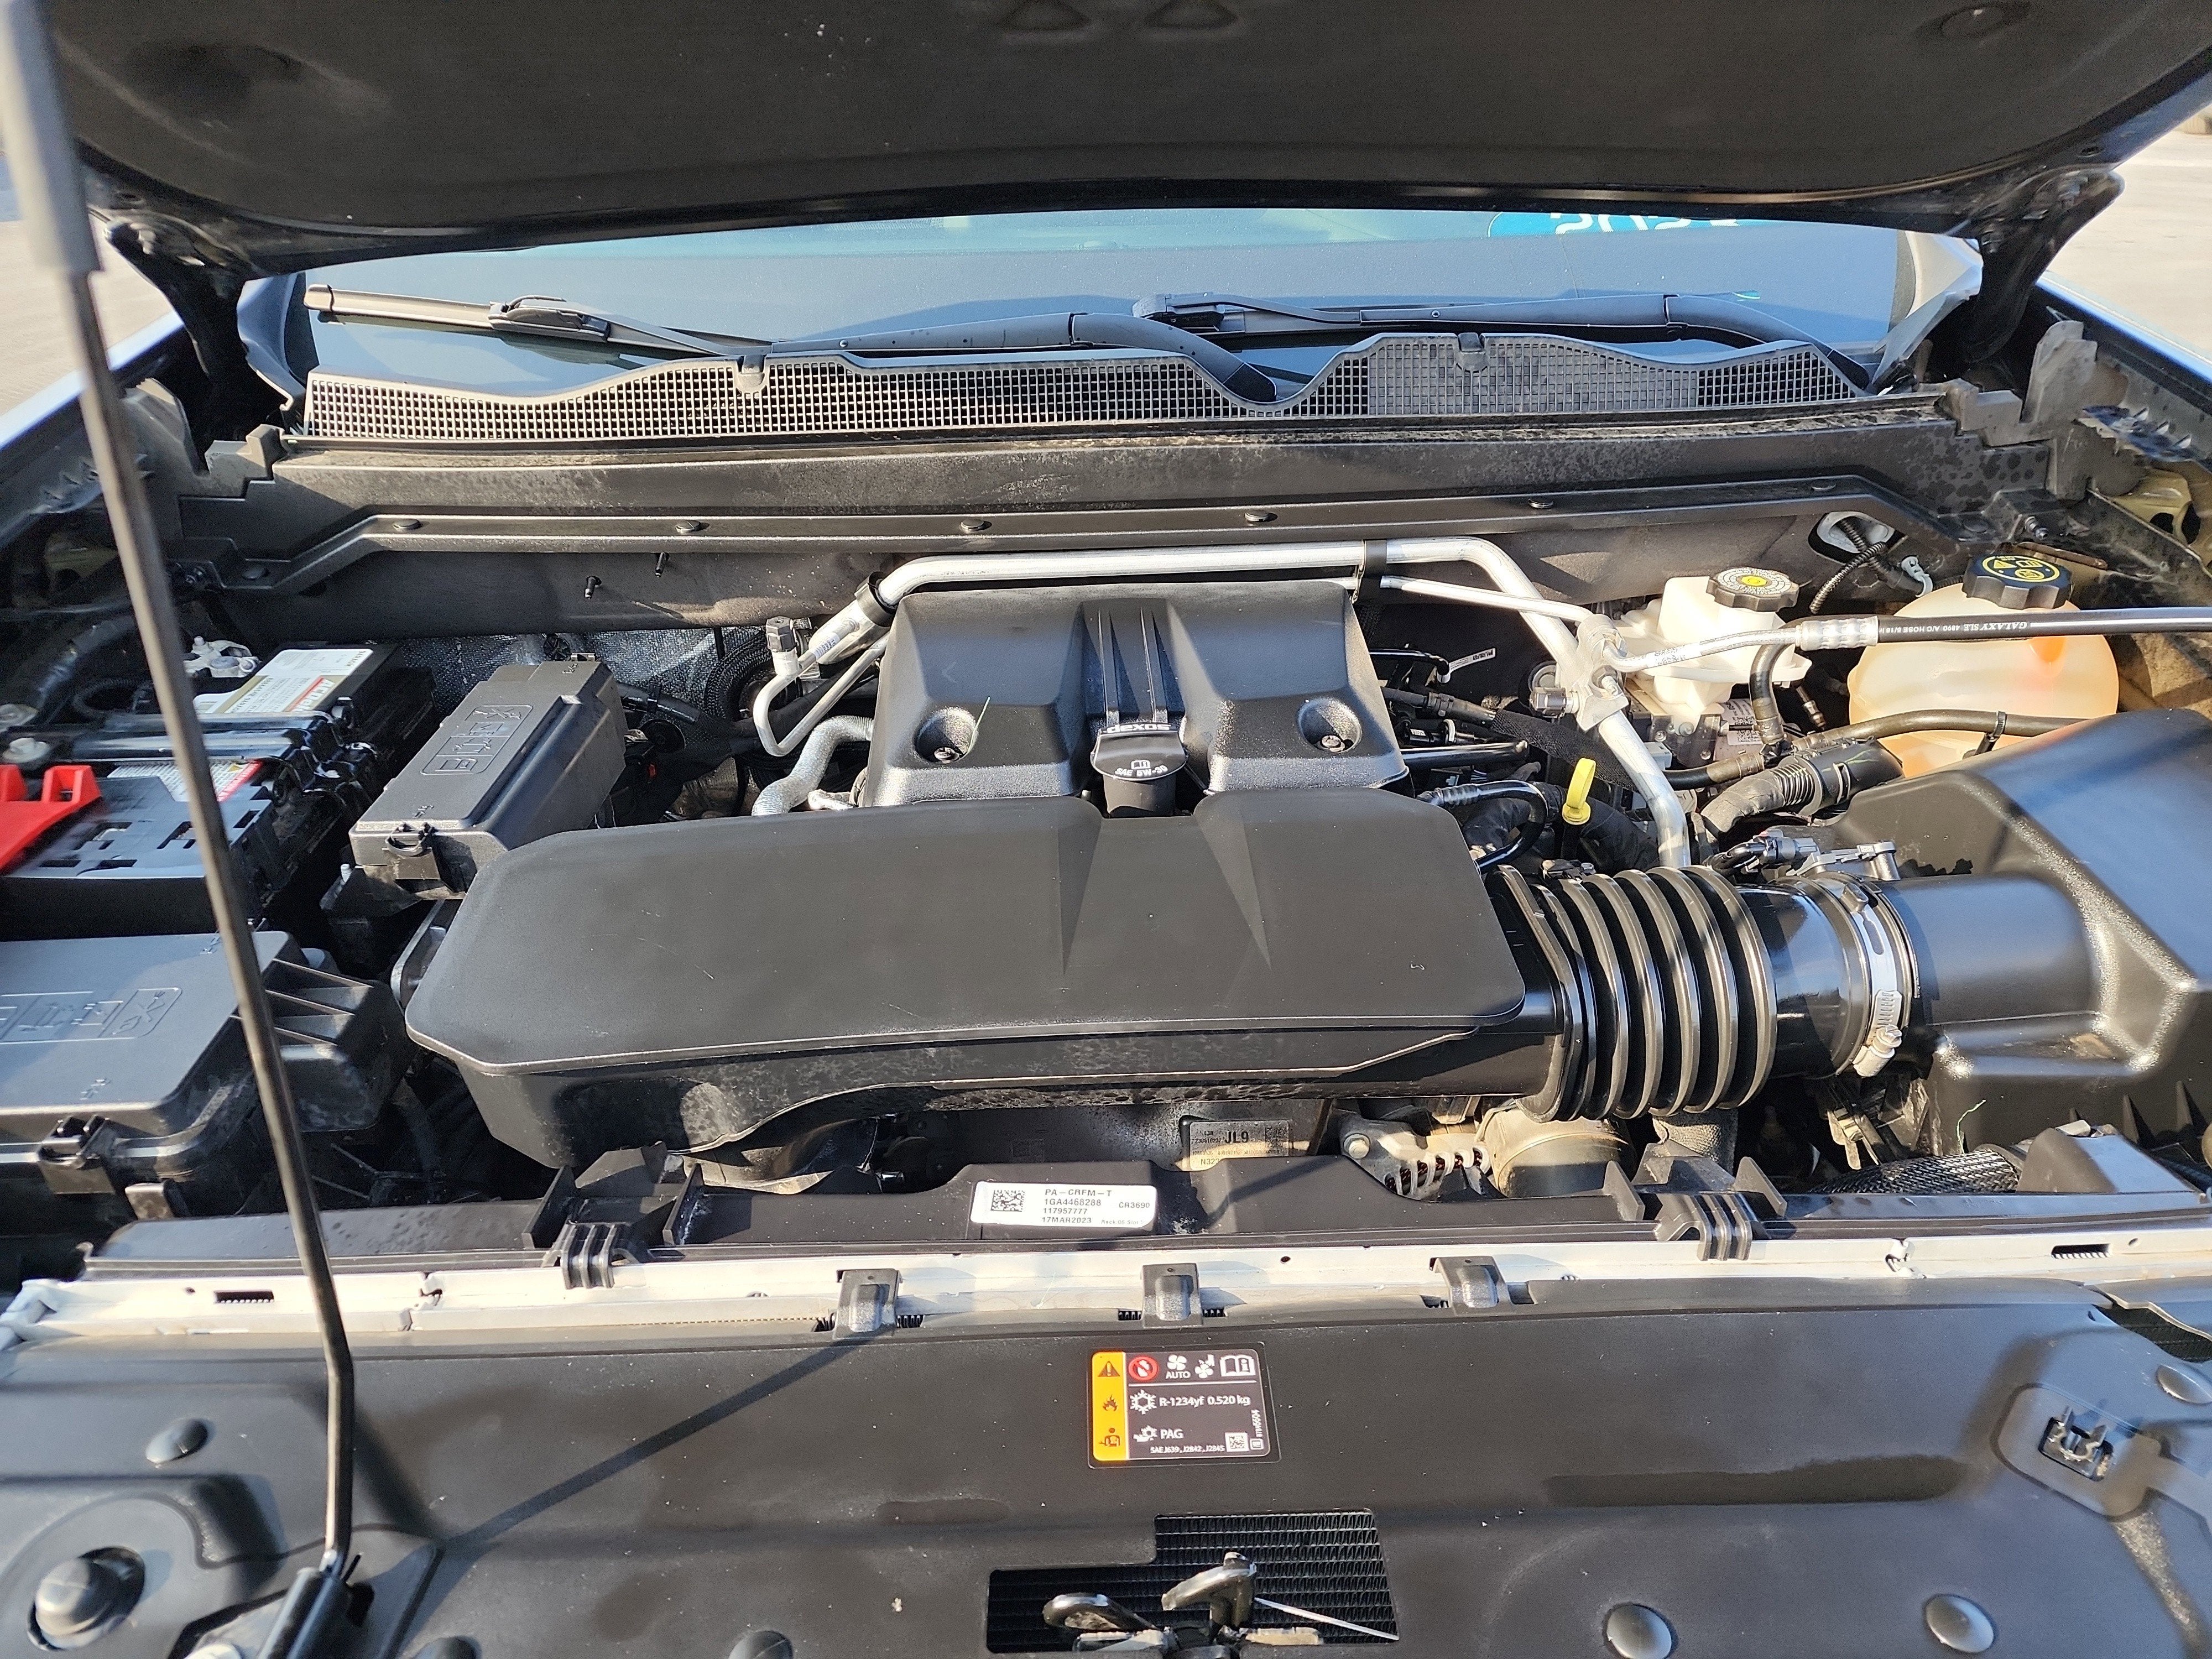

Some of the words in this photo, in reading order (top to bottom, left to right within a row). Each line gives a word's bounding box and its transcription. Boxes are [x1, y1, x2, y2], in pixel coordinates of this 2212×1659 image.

[1963, 623, 1979, 632] SLE
[1980, 622, 2028, 630] GALAXY
[1107, 724, 1171, 733] dexos
[1114, 768, 1133, 776] SAE
[1136, 765, 1168, 776] 5W-30
[1224, 1131, 1249, 1144] JL9
[1165, 1370, 1191, 1379] AUTO
[1159, 1395, 1204, 1408] R-1234yf
[1207, 1396, 1235, 1405] 0.520
[1237, 1395, 1250, 1406] kg
[1161, 1429, 1183, 1439] PAG
